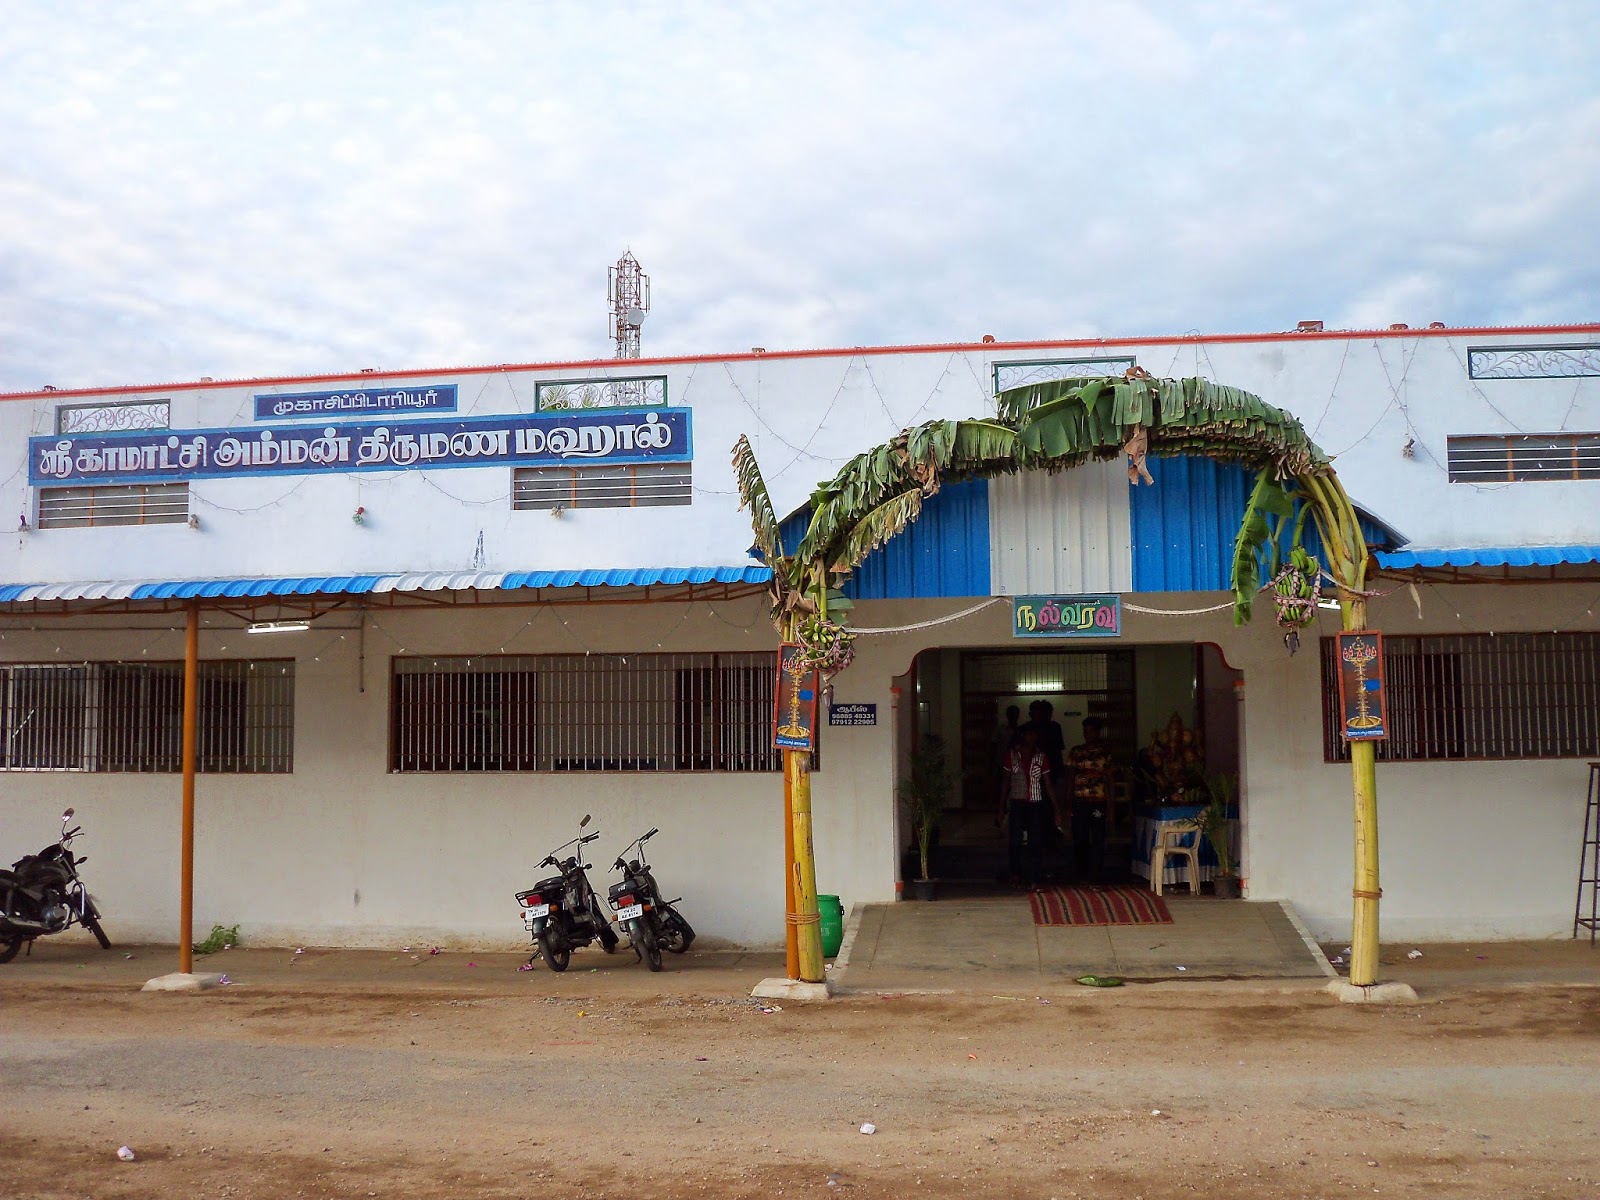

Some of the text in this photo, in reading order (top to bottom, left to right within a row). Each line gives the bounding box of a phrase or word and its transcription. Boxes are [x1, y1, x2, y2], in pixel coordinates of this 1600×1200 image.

[273, 389, 438, 416] முகாசிப்பிடாரியூர்
[75, 435, 208, 473] காமாட்சி
[213, 427, 352, 467] அம்மன்
[355, 426, 511, 467] திருமண
[515, 412, 672, 459] மஹால்
[1016, 600, 1117, 632] நல்வரவு
